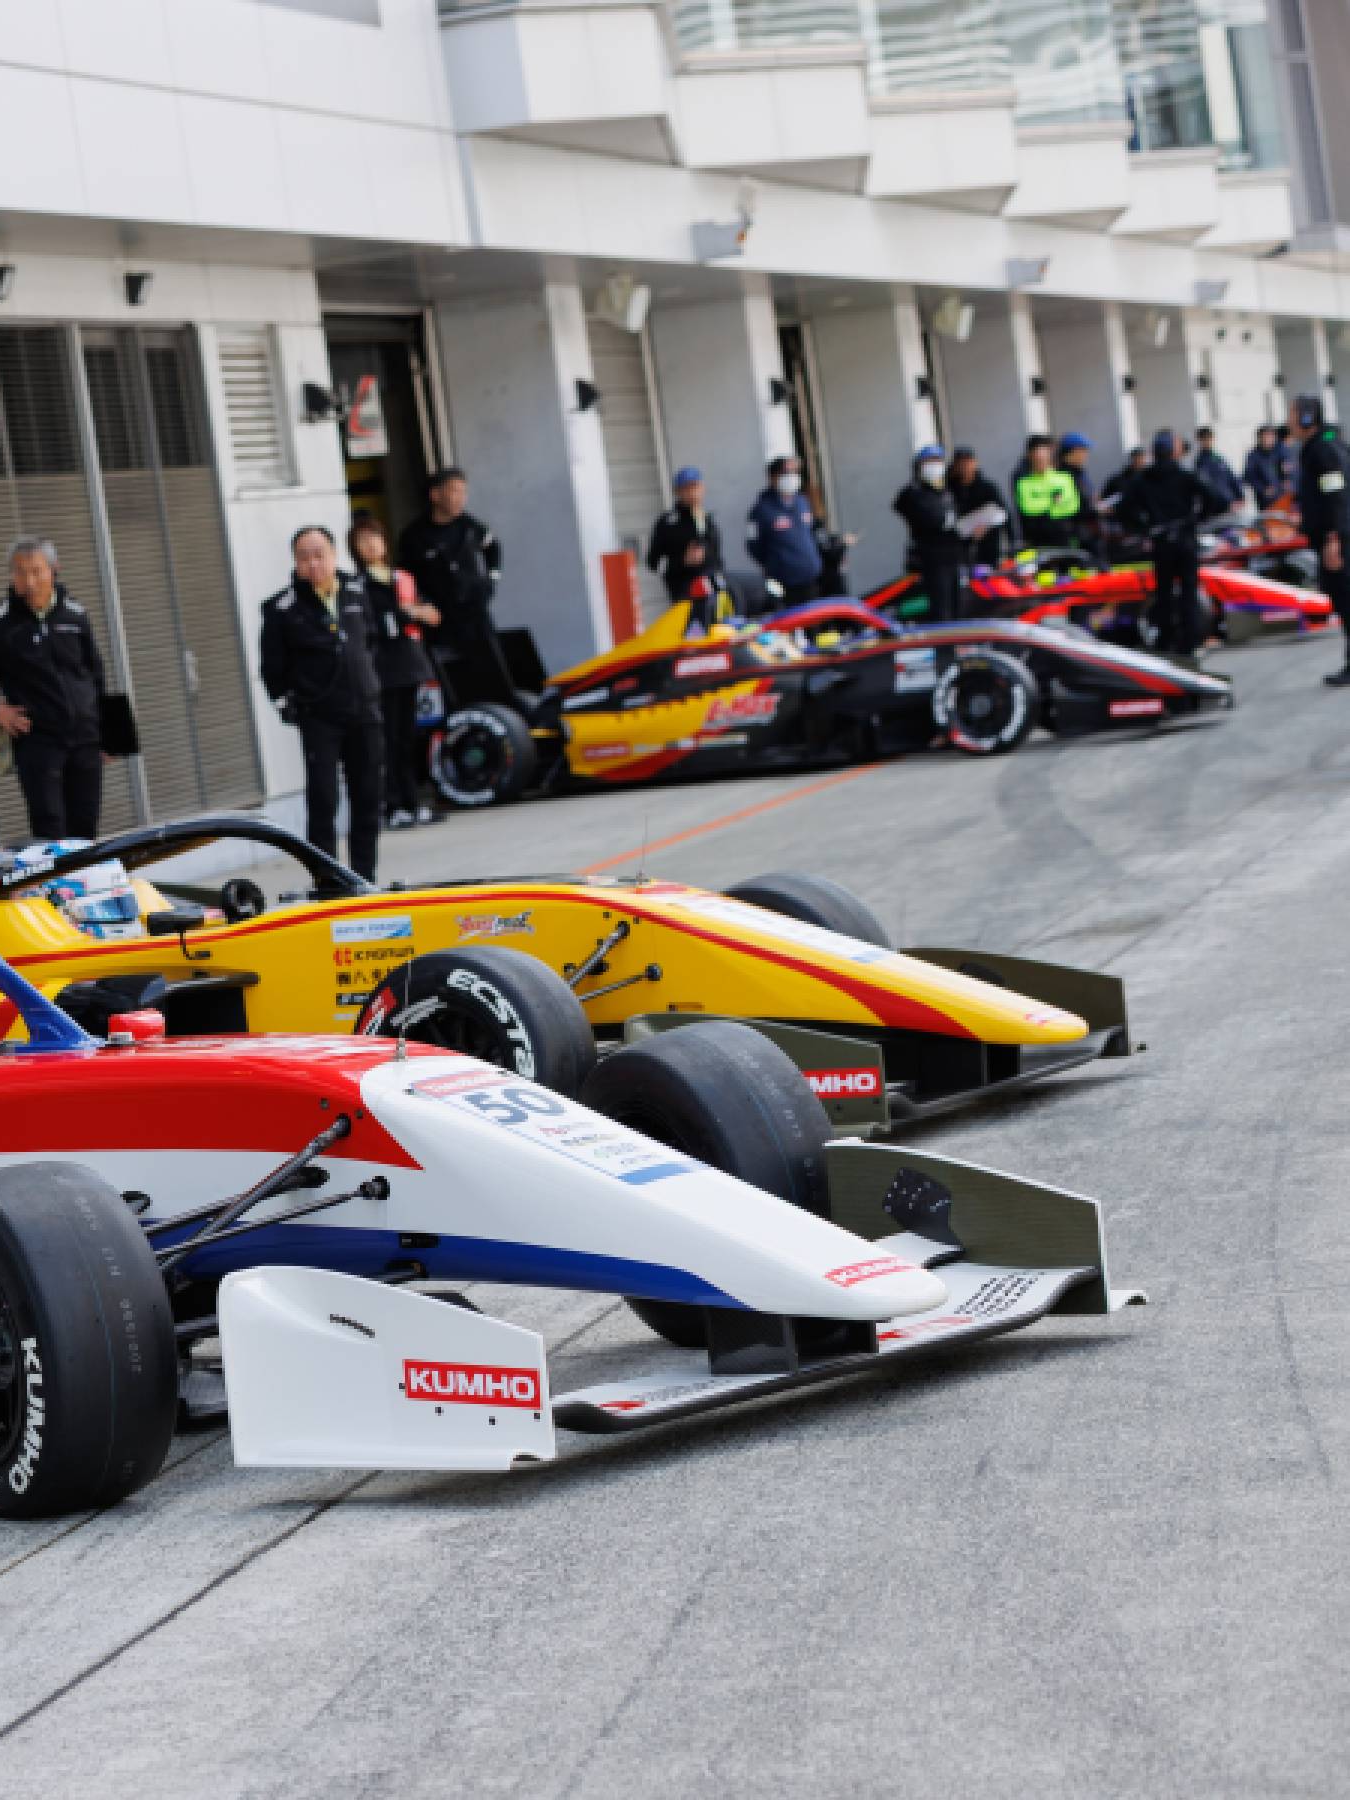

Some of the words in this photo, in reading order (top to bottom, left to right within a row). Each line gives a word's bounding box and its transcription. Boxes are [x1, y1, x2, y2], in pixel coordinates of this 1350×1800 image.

[808, 1073, 876, 1093] MHO
[463, 1087, 565, 1125] 50
[409, 1367, 536, 1402] KUMHO
[8, 1336, 46, 1495] KUMHO
